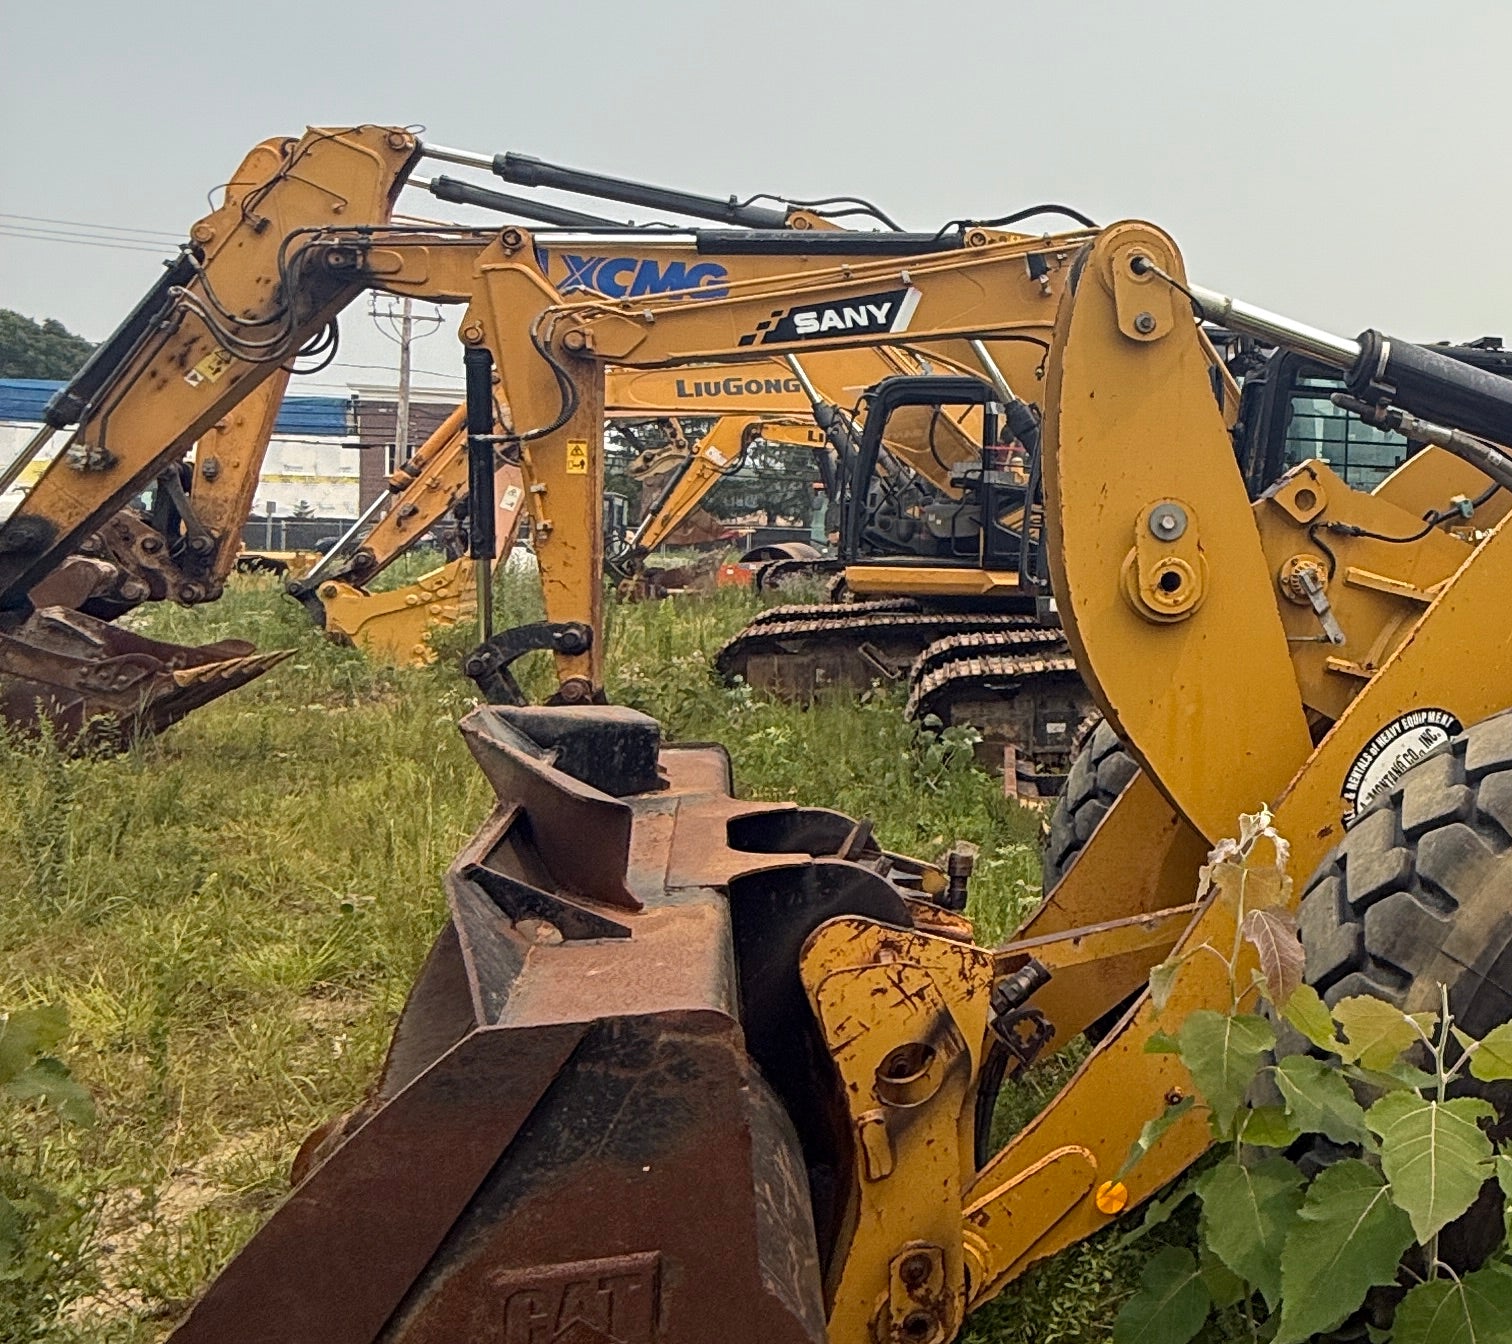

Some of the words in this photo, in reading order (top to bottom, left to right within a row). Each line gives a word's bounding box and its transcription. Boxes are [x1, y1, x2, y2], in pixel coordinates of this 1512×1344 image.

[556, 254, 730, 301] XCMG
[793, 302, 892, 335] SANY
[1347, 752, 1373, 793] RENTALS
[1375, 721, 1402, 749] HEAVY
[1401, 711, 1454, 730] EQUIPMENT
[1418, 728, 1442, 750] INC.
